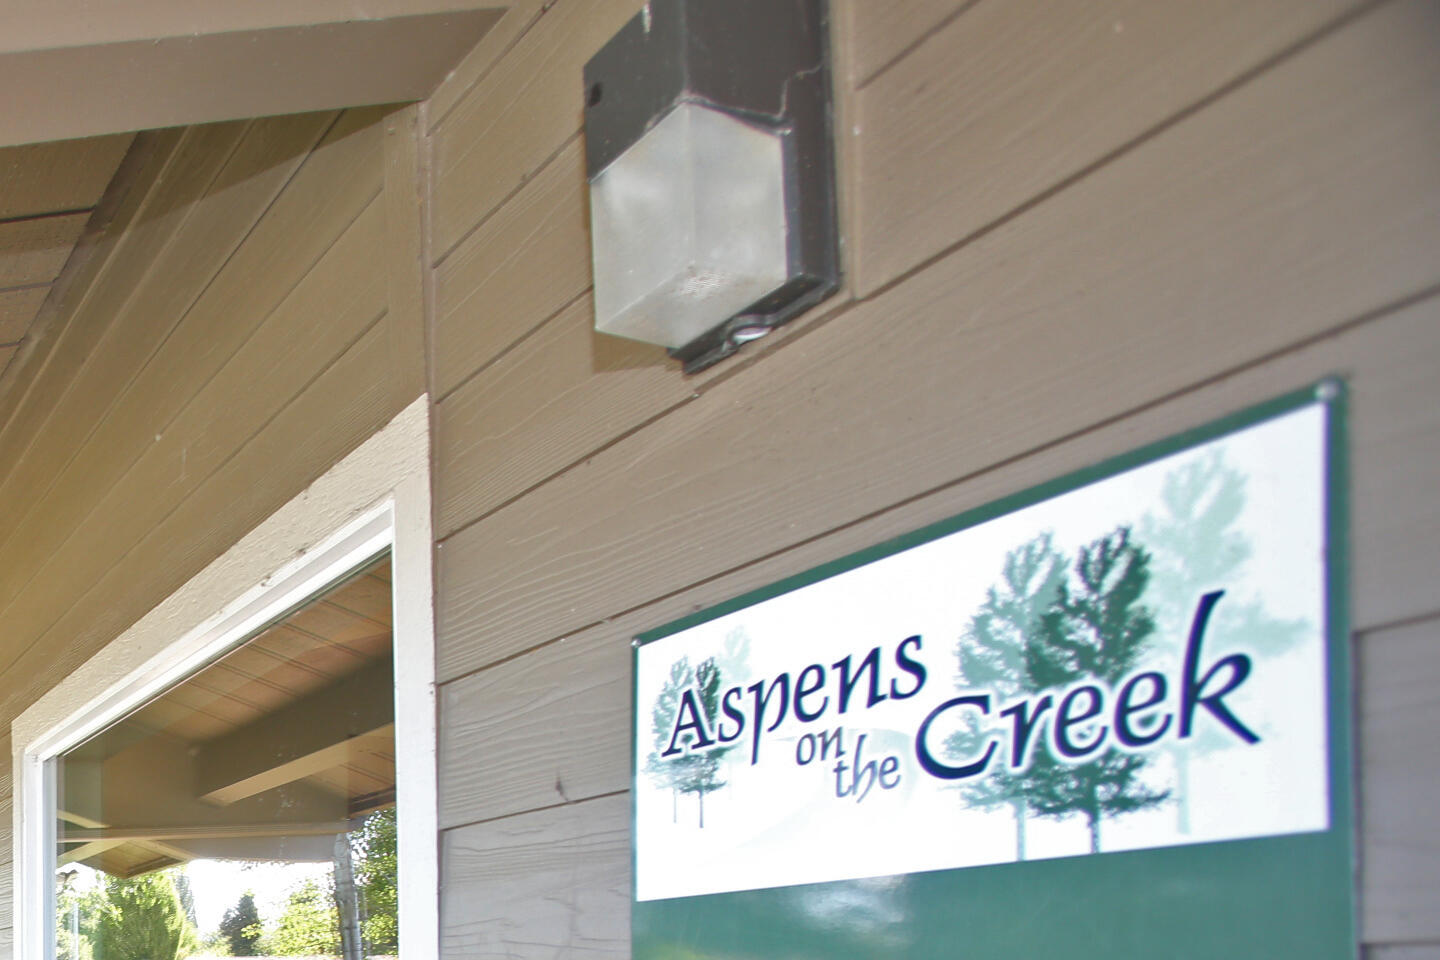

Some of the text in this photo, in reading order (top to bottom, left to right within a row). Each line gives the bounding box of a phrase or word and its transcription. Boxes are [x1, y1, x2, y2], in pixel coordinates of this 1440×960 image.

[661, 634, 927, 765] Aspens
[915, 590, 1261, 780] Creek
[795, 726, 846, 768] on
[834, 733, 901, 804] the
